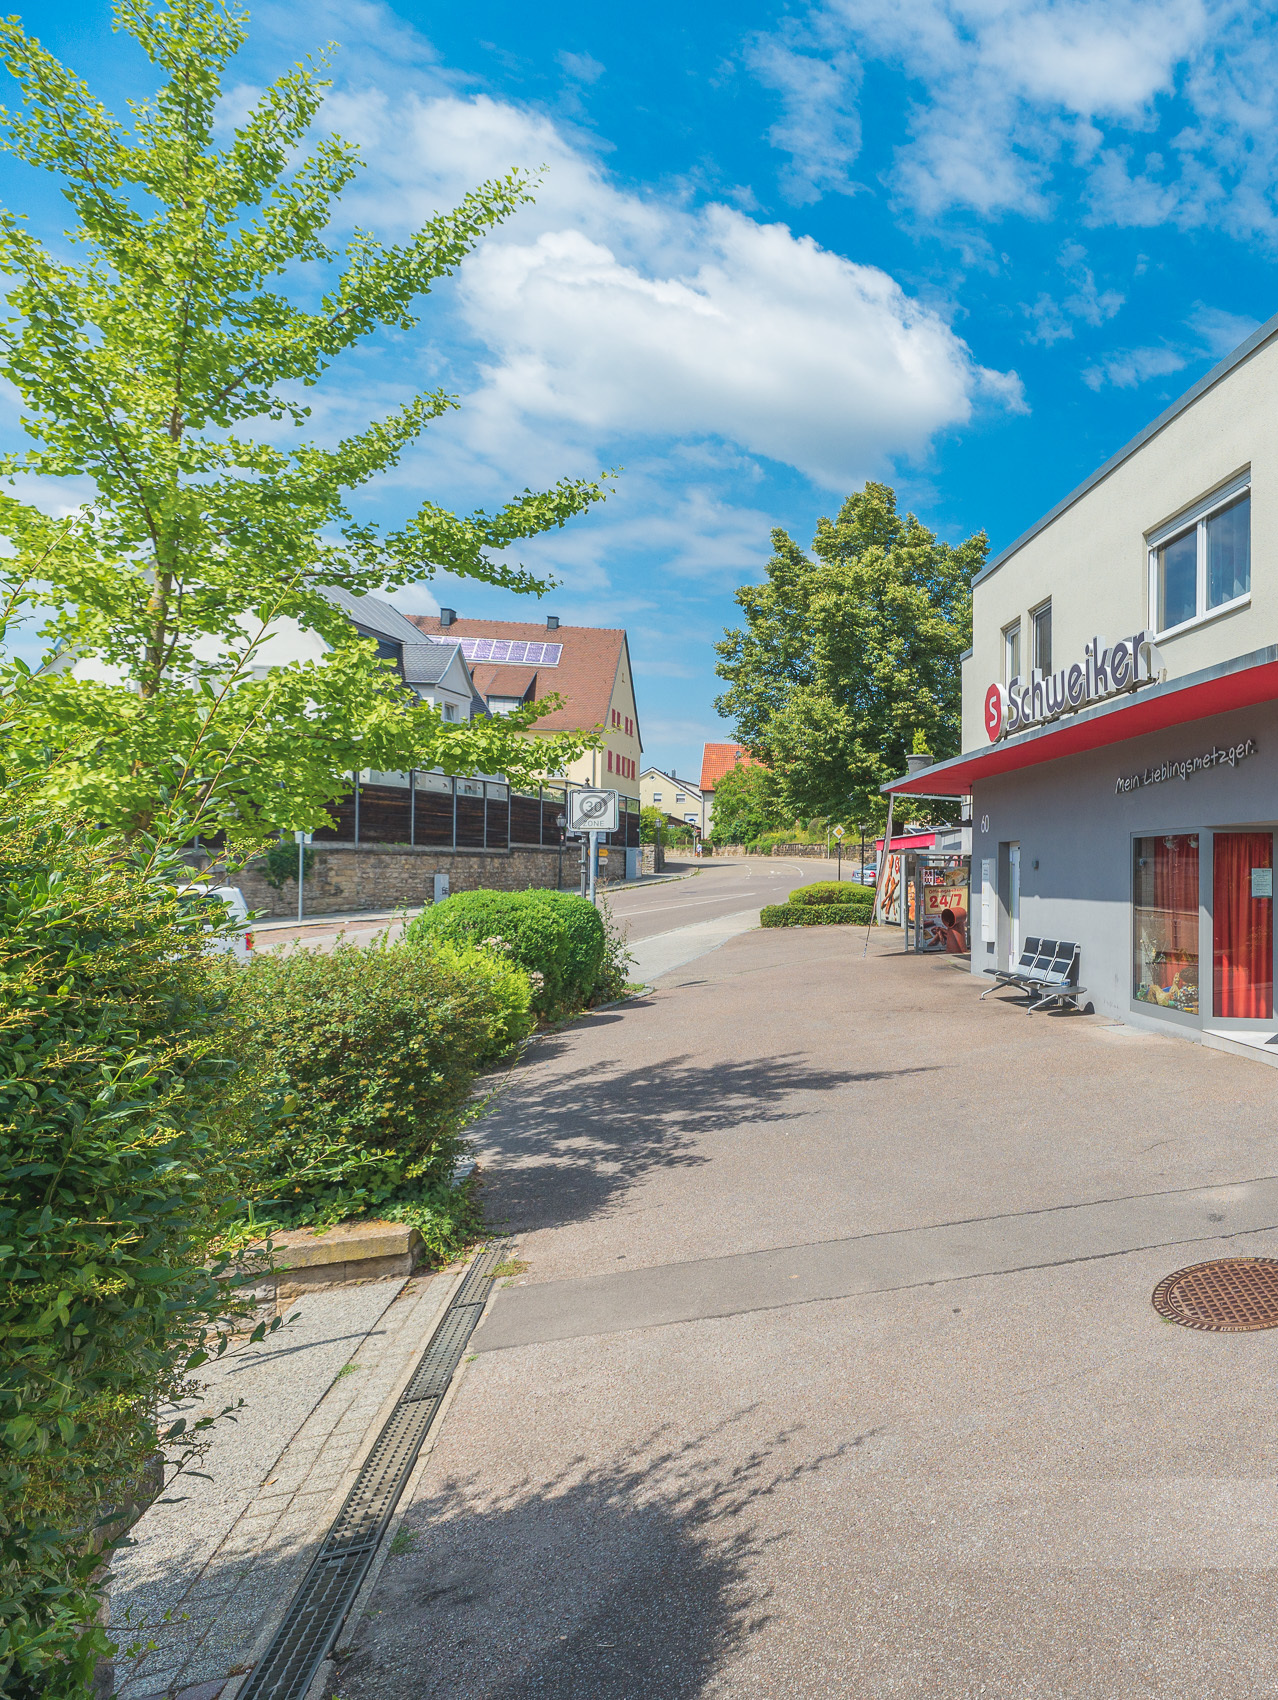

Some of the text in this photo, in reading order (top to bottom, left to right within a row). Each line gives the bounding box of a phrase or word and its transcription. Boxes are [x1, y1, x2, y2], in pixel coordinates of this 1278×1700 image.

[1007, 631, 1146, 731] Schweiker
[1115, 777, 1140, 794] Mein
[585, 800, 602, 812] 30
[980, 814, 990, 833] 60
[929, 893, 962, 909] 24/7
